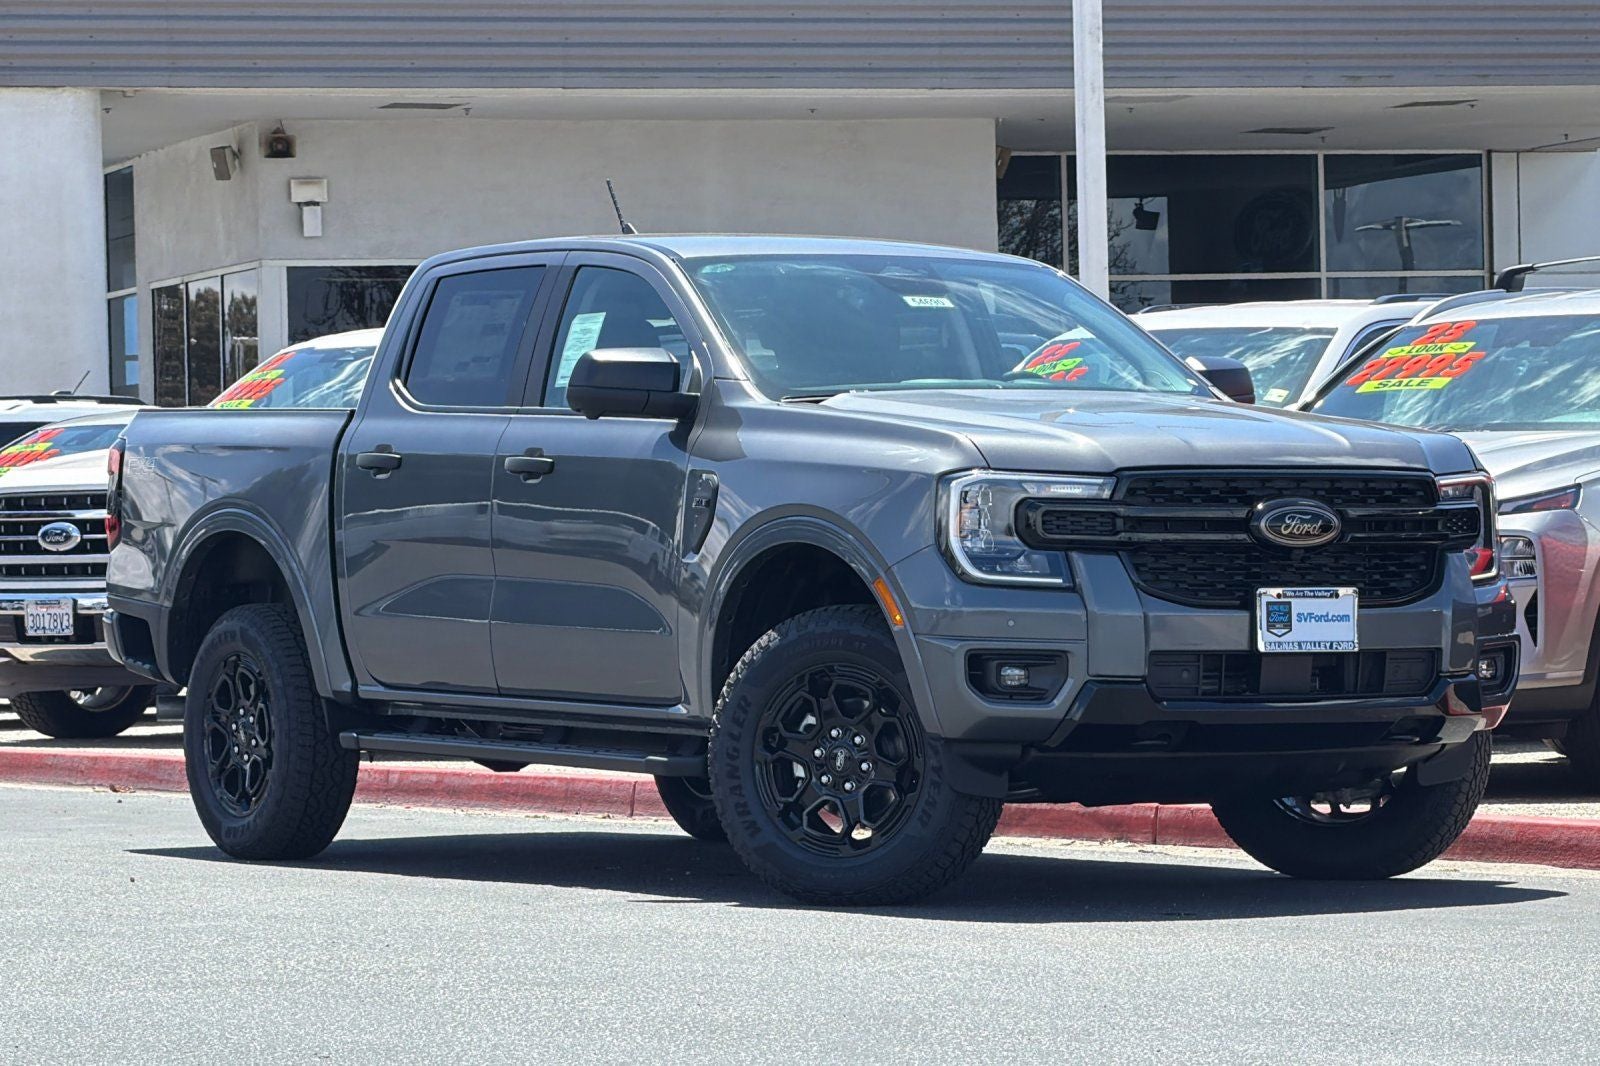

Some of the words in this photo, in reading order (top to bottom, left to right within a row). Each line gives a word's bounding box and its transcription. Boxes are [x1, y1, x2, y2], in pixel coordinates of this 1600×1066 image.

[1410, 320, 1477, 346] 23
[1408, 344, 1450, 354] LOOK
[1345, 351, 1486, 386] 27995
[1374, 379, 1433, 388] SALE
[1281, 513, 1323, 535] Ford
[45, 529, 67, 543] Ford
[29, 612, 71, 630] 30178V3
[1296, 611, 1351, 623] SVFord.com
[1301, 641, 1331, 650] VALLEY
[726, 693, 762, 838] WRANGLER
